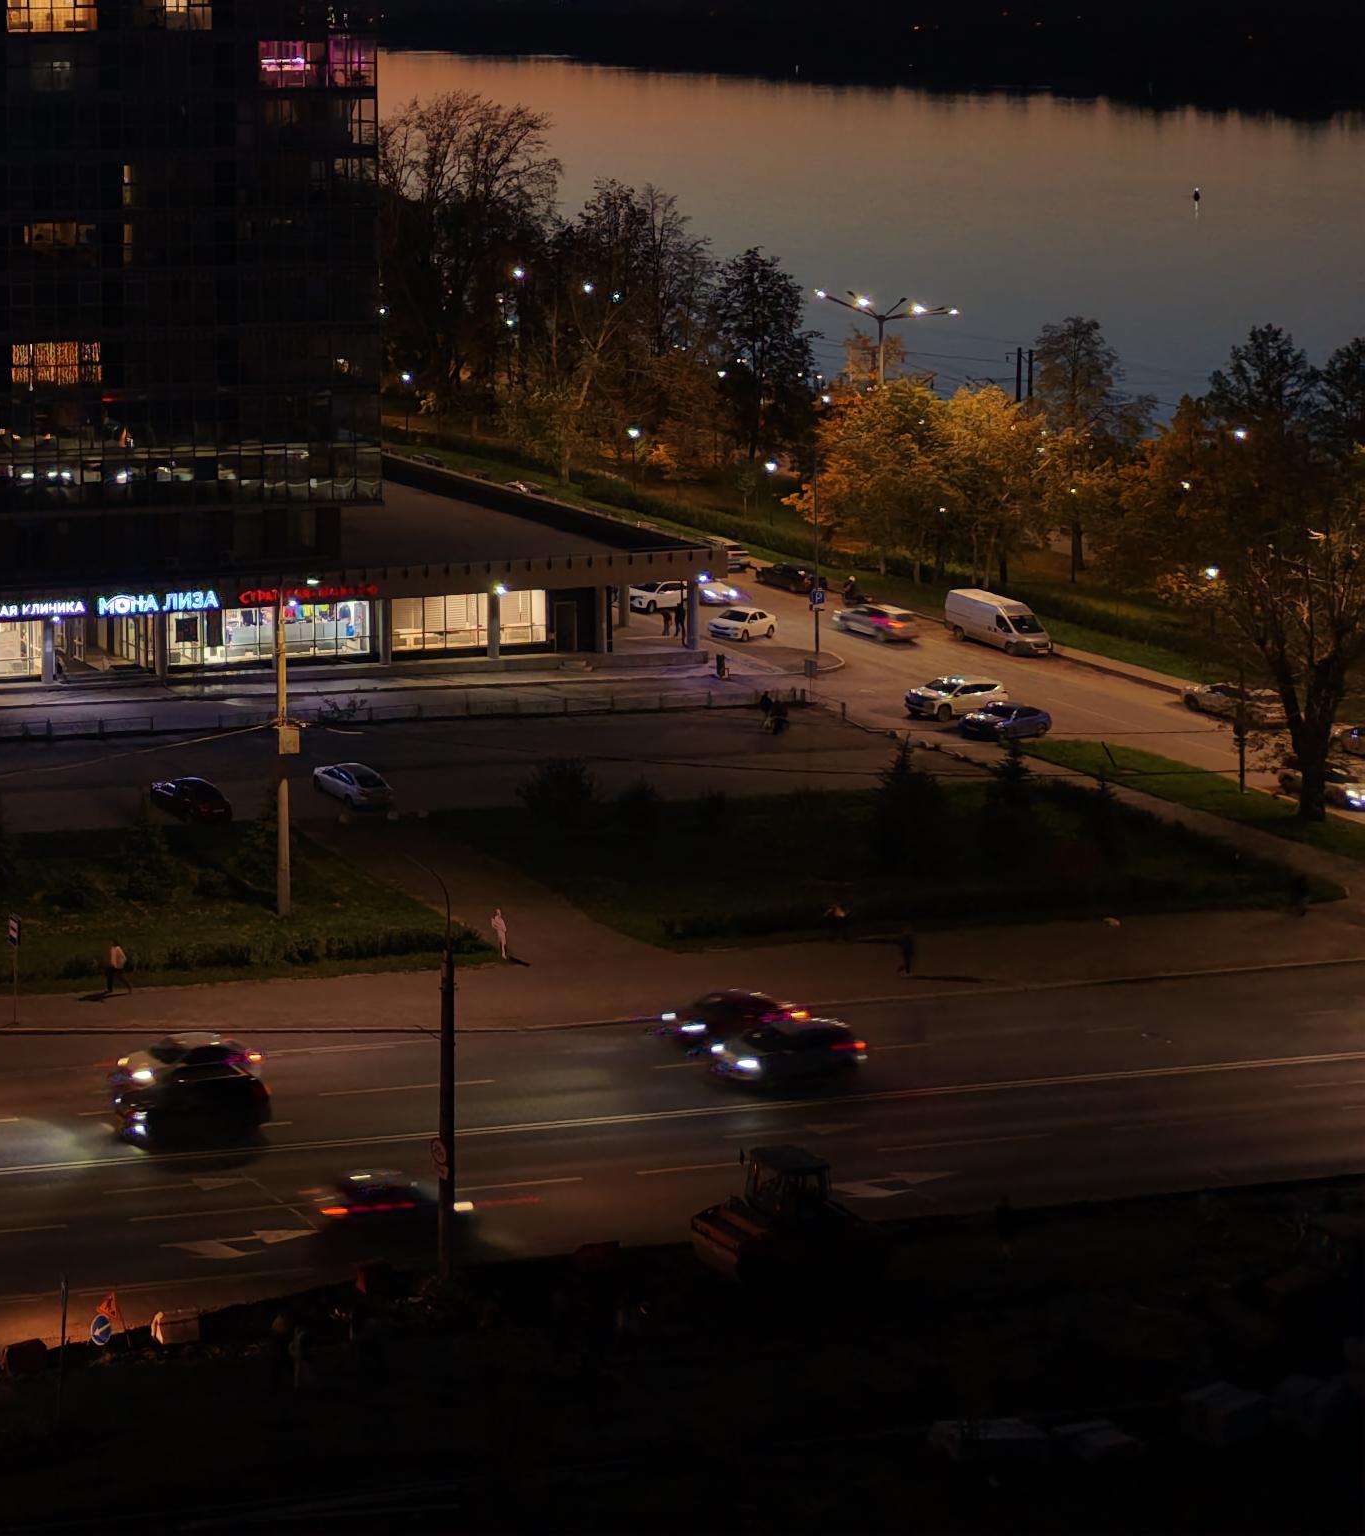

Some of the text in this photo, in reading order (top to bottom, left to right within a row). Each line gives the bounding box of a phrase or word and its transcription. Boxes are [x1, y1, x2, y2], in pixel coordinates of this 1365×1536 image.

[21, 600, 85, 615] КЛИНИКА
[98, 590, 219, 615] МОНА ЛИЗА
